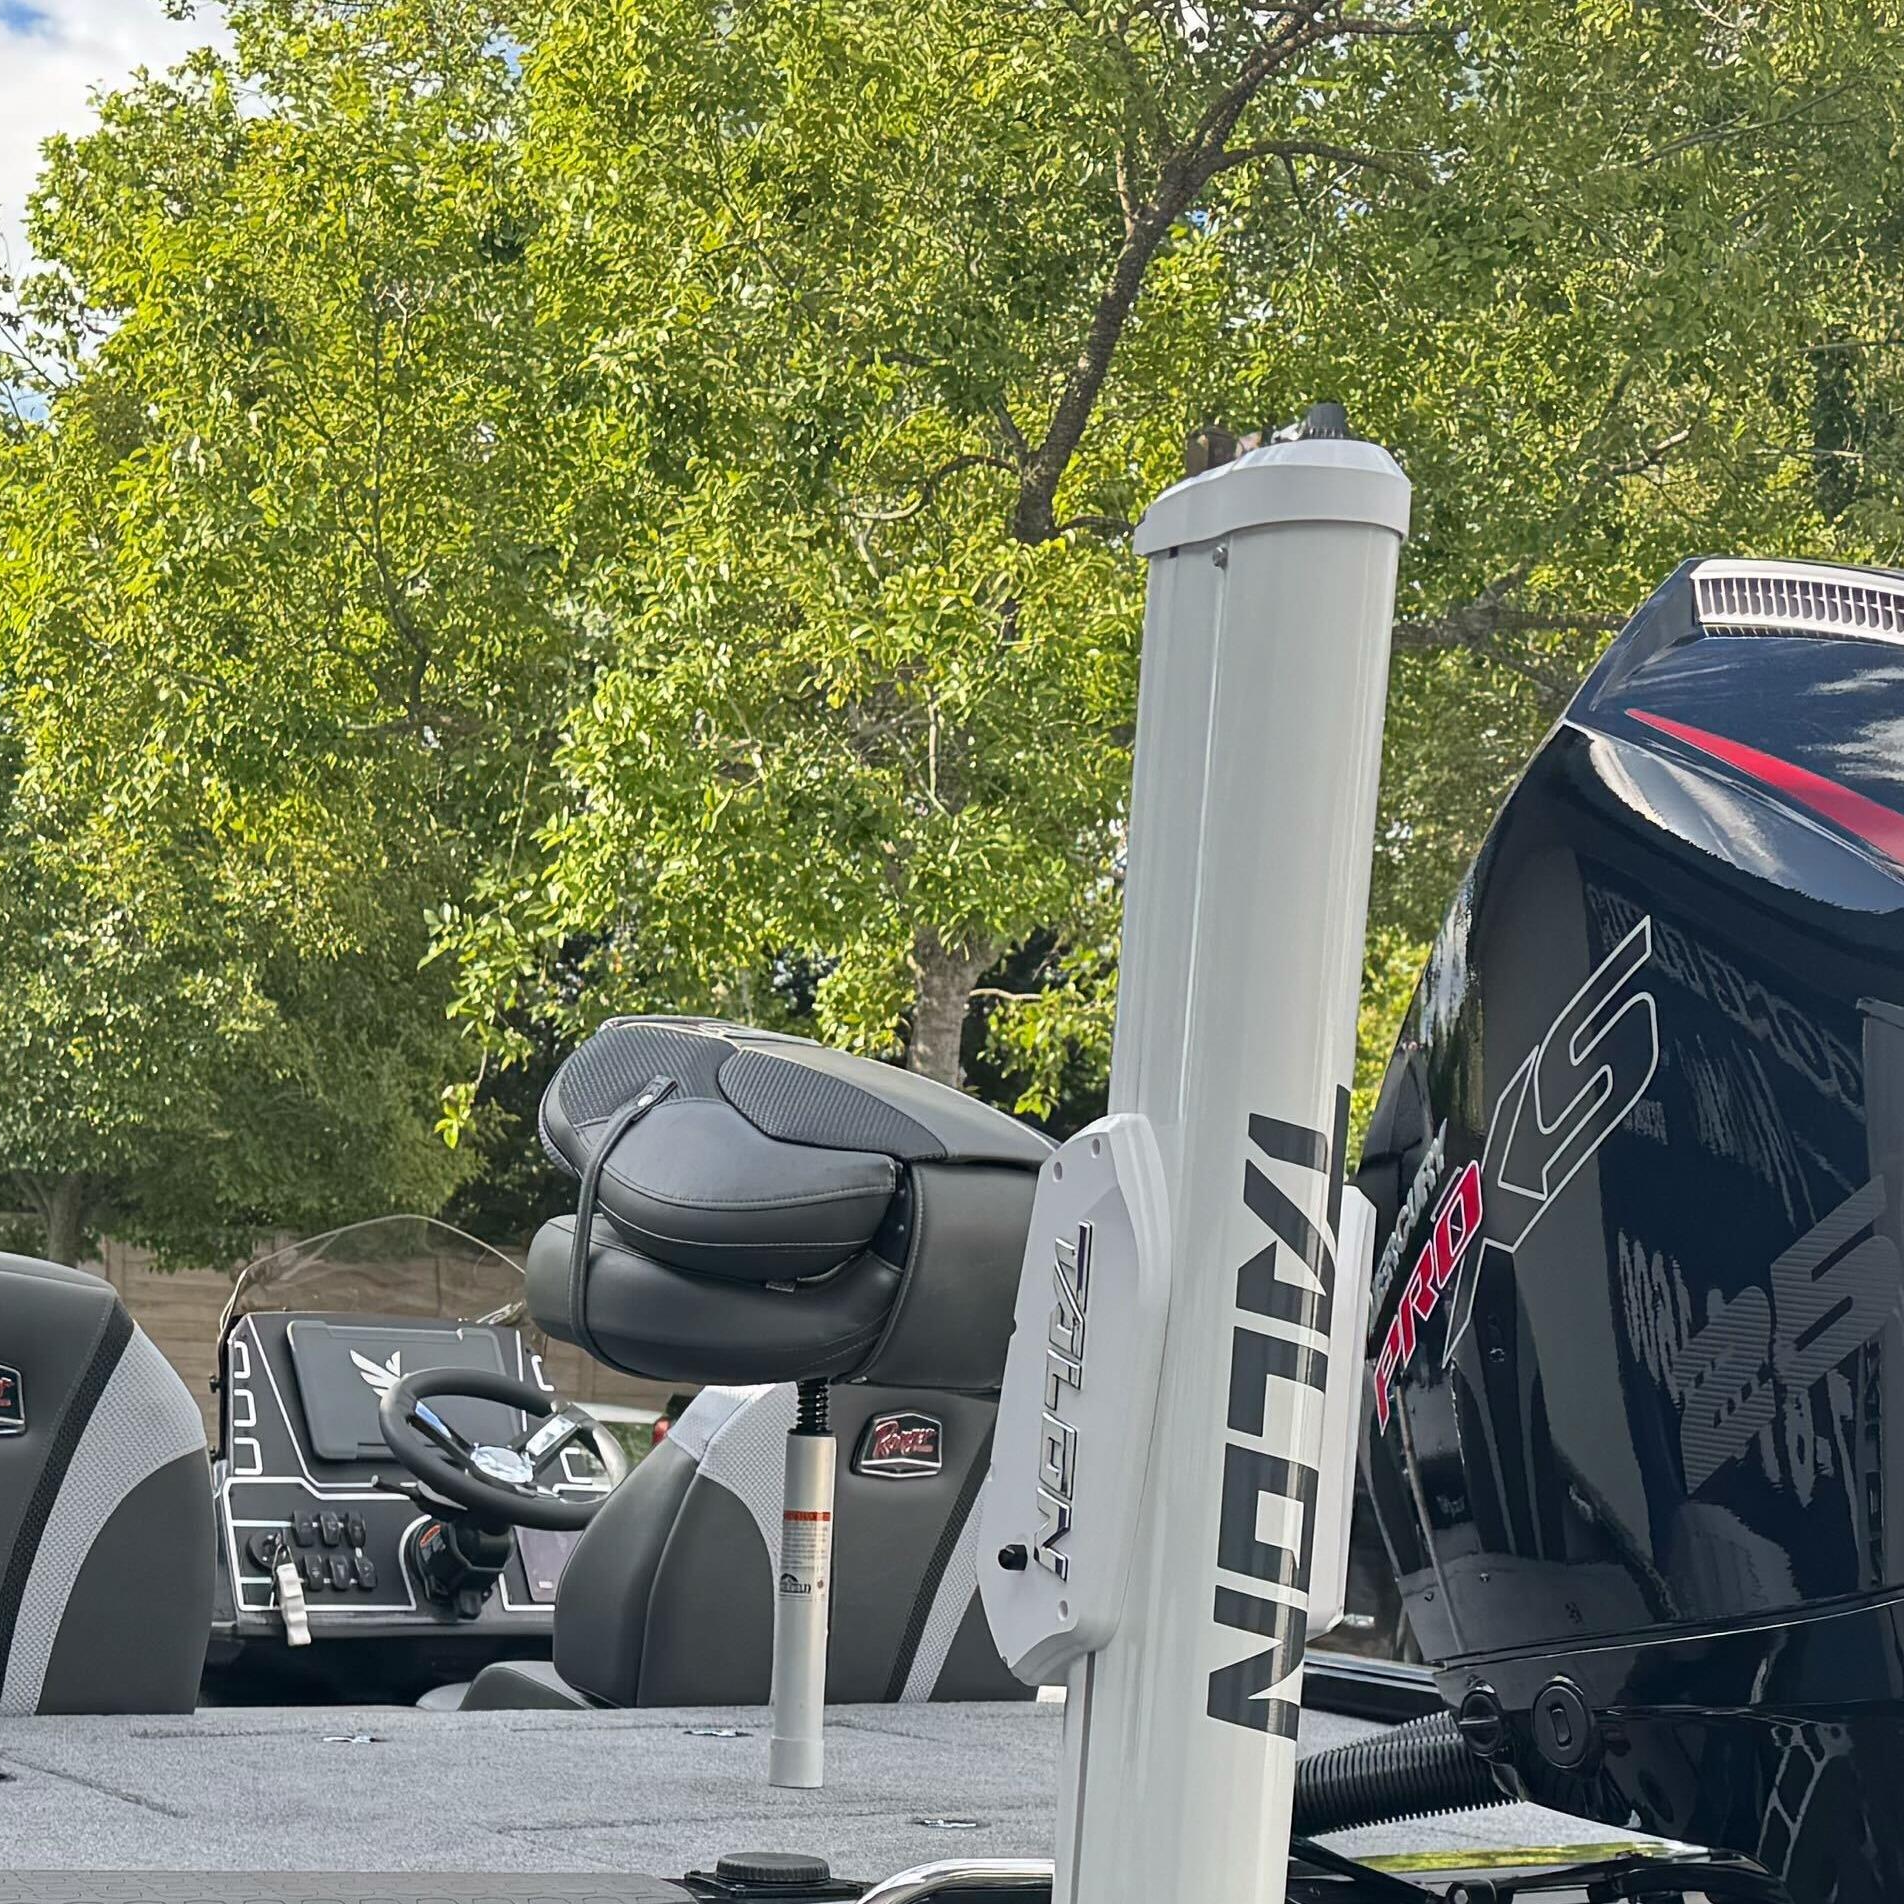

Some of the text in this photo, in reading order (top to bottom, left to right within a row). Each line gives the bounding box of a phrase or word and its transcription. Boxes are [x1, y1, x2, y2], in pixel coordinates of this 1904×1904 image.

[1033, 1220, 1095, 1582] TALON
[1206, 1083, 1351, 1742] TALON
[1375, 915, 1660, 1438] PRO XS
